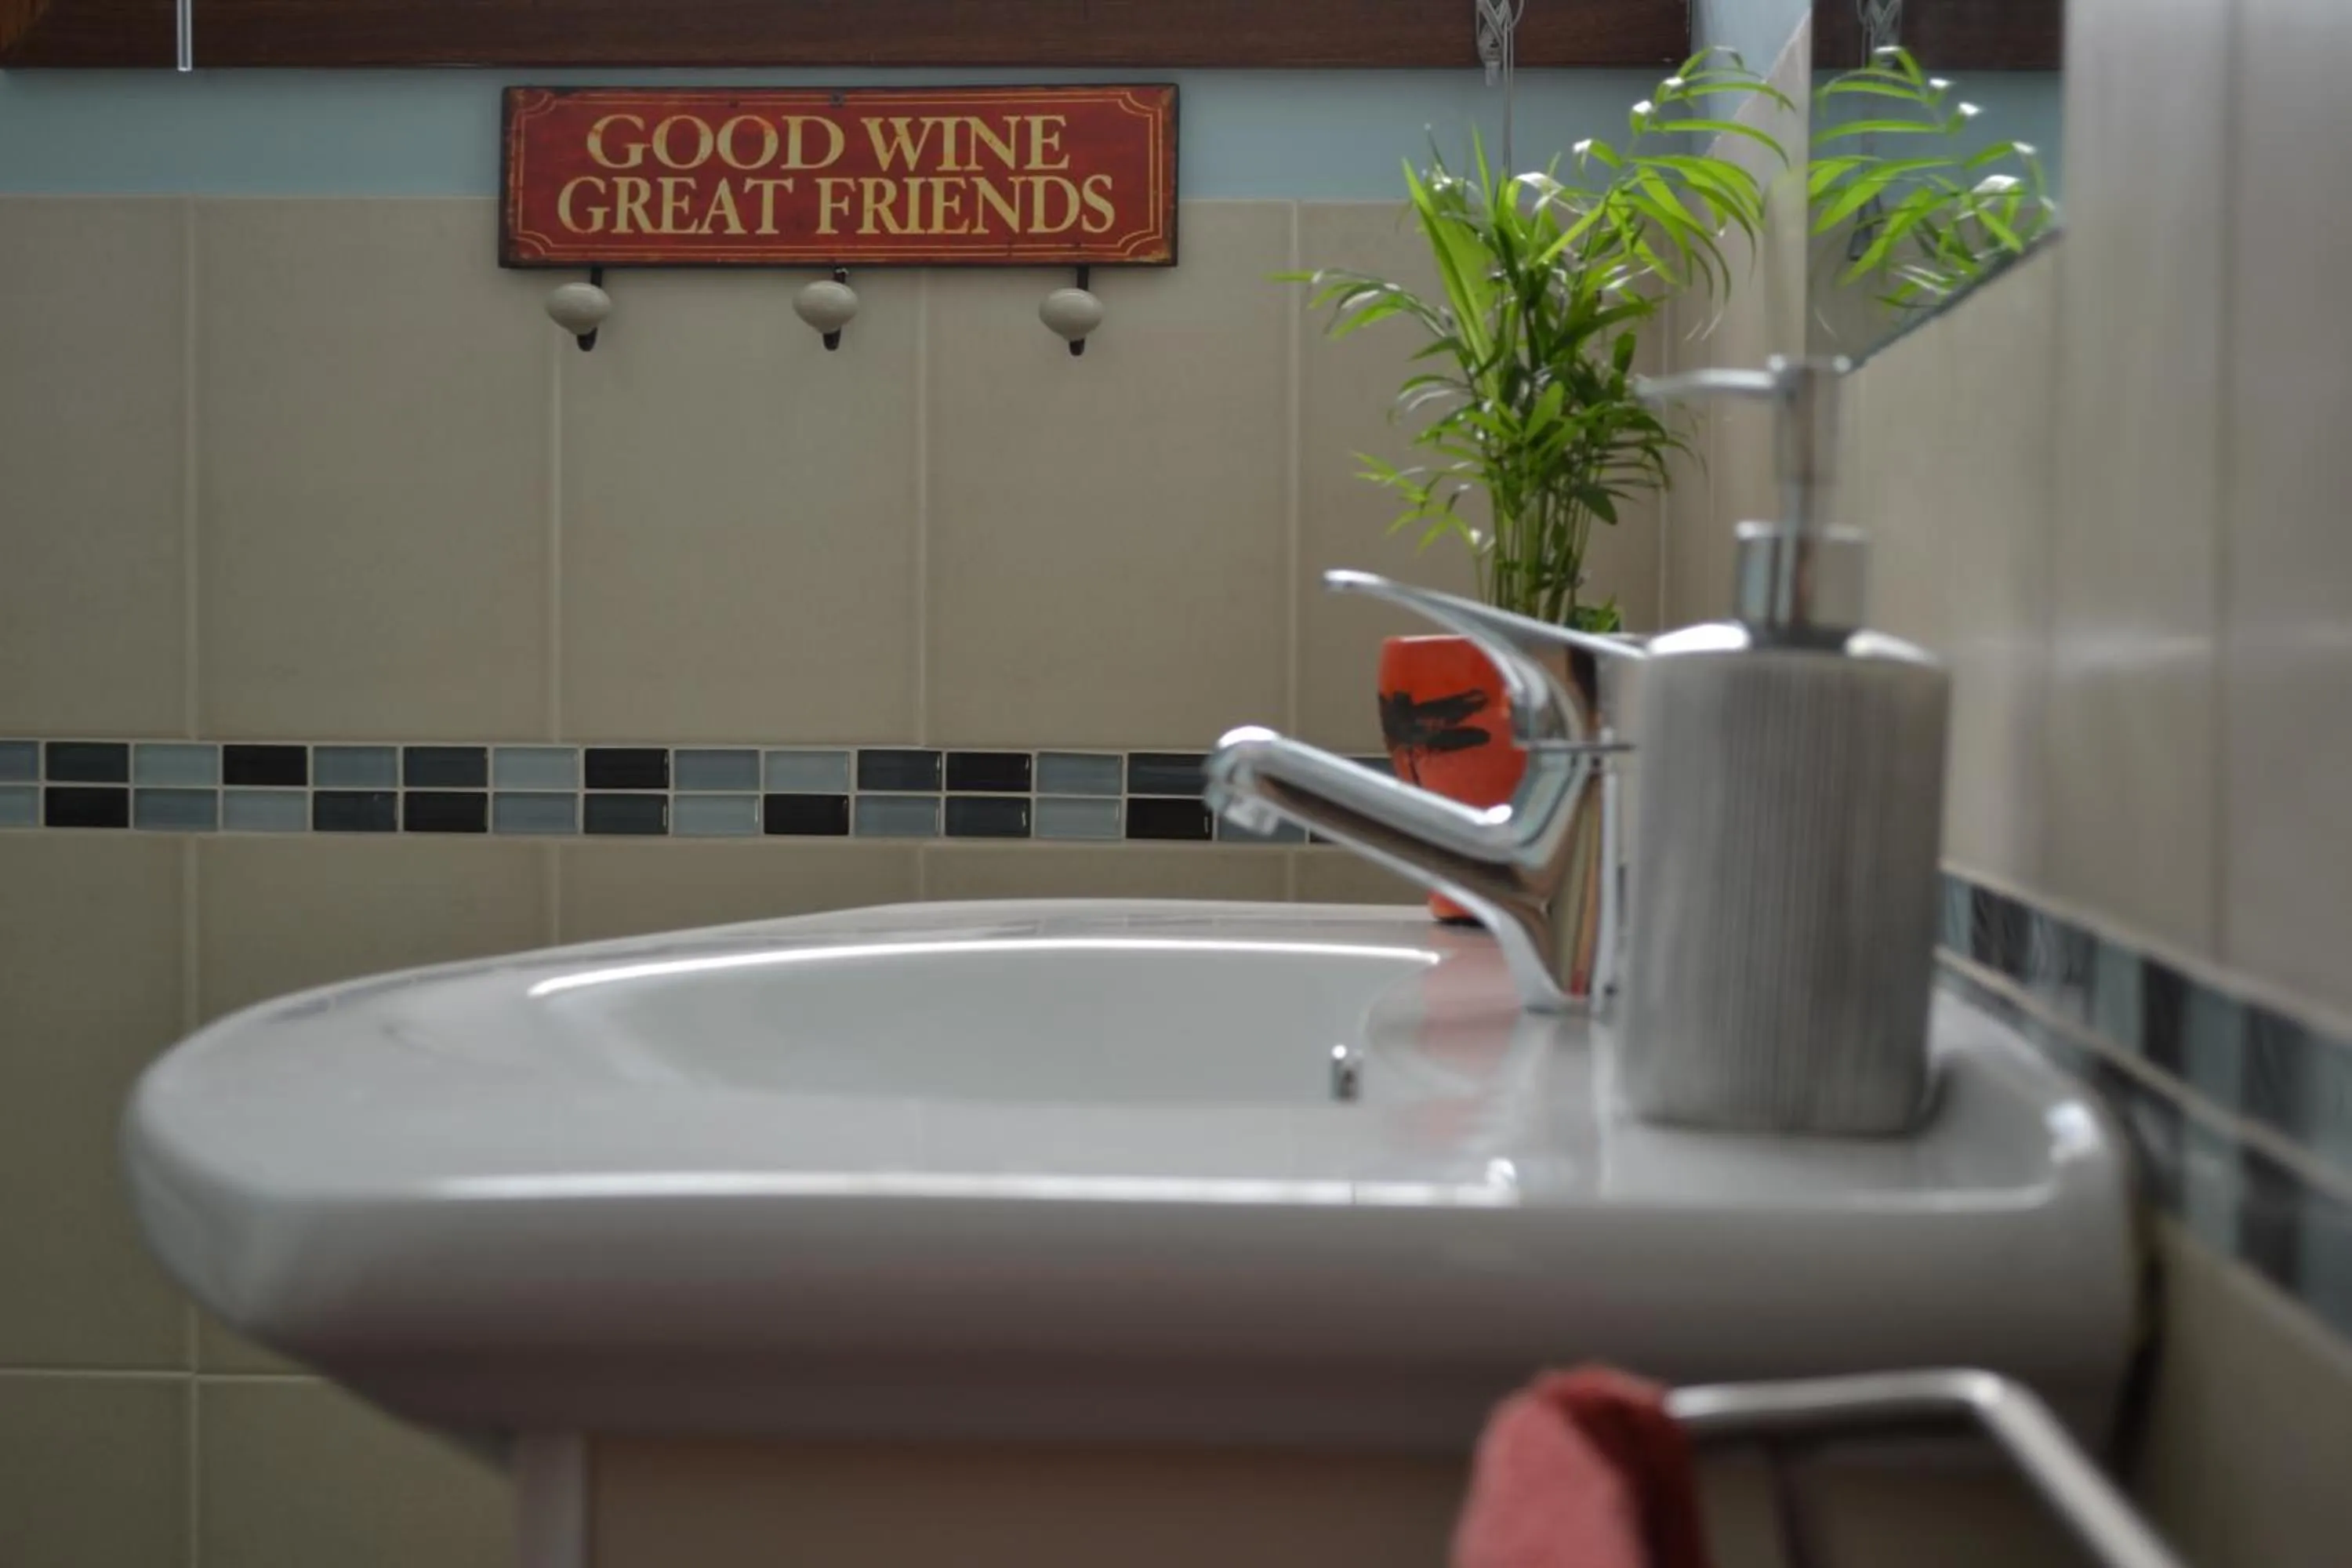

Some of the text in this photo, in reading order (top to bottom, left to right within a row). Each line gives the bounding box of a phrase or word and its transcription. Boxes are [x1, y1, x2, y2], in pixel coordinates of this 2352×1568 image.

[586, 115, 1070, 171] GOOD WINE
[557, 175, 1116, 234] GREAT FRIENDS
